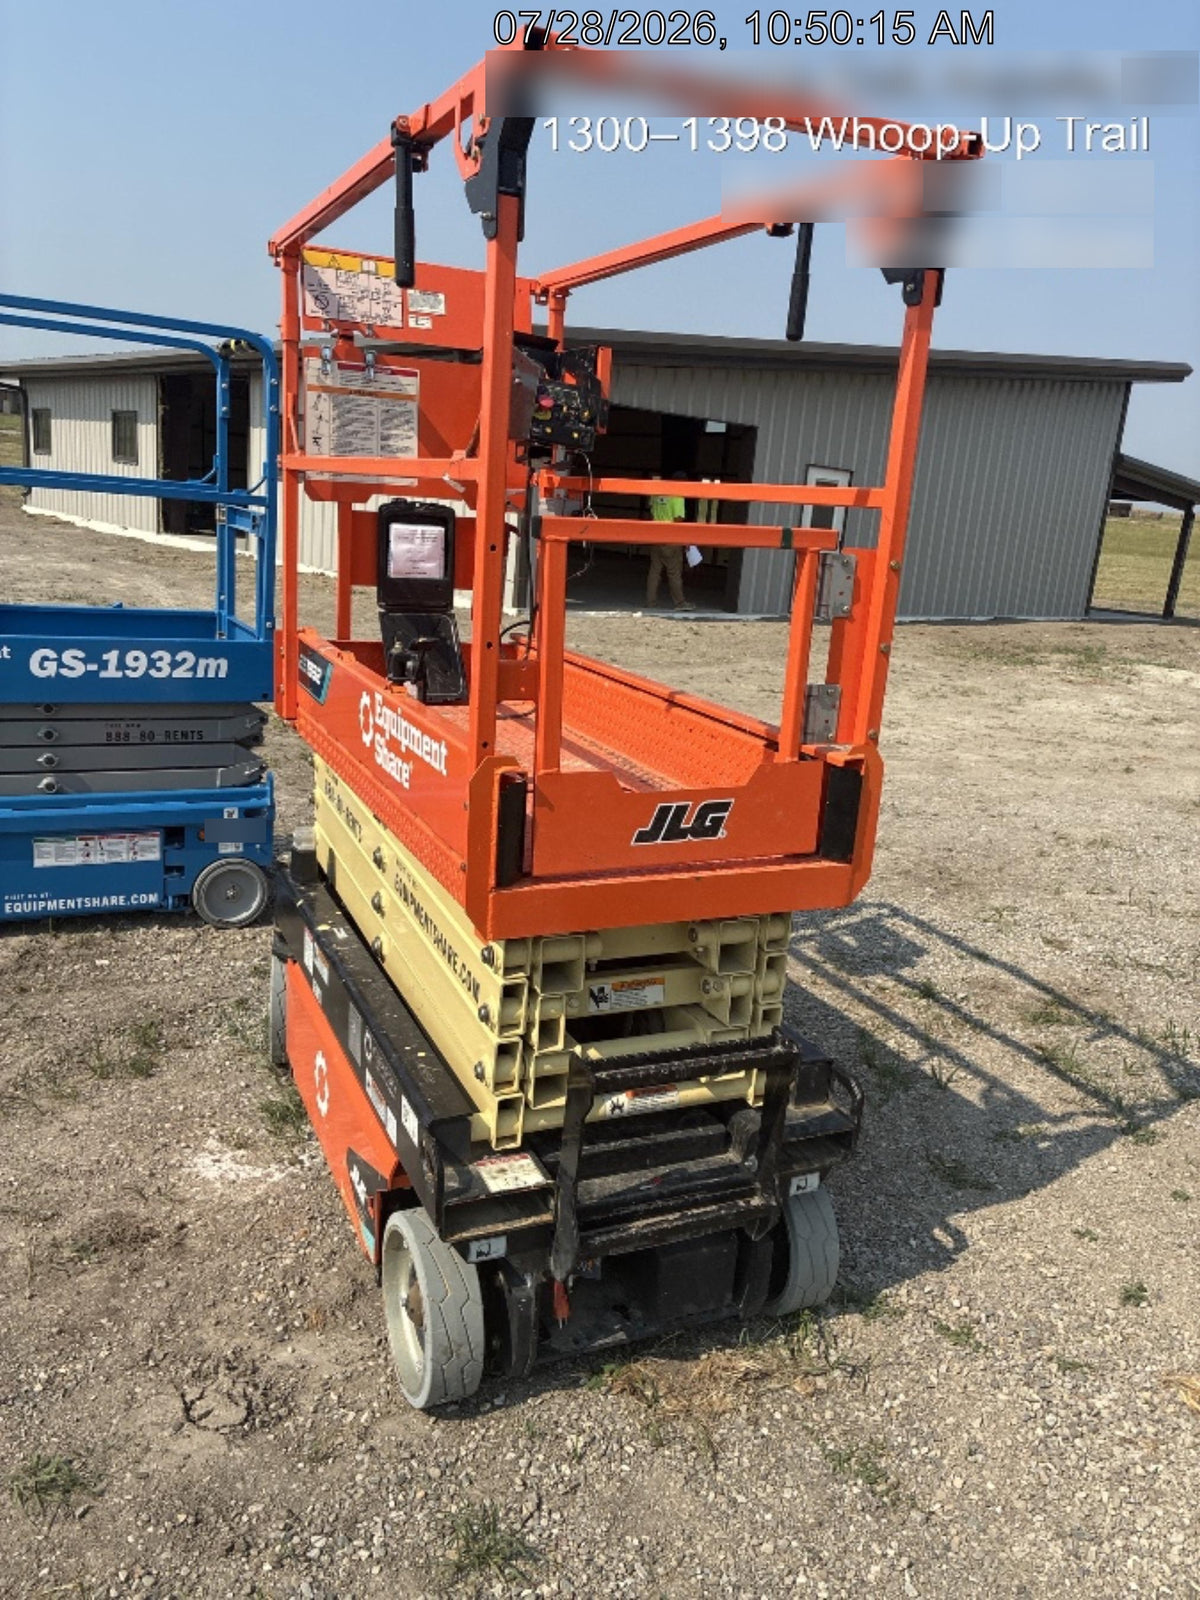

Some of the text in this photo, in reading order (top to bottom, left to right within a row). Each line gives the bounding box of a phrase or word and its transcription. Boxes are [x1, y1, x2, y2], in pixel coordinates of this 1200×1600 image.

[29, 648, 229, 678] GS-1932m
[374, 691, 448, 777] Equipment
[374, 732, 410, 790] Share
[631, 798, 735, 846] JLG
[4, 892, 159, 914] EQUIPMENTSHARE.COM
